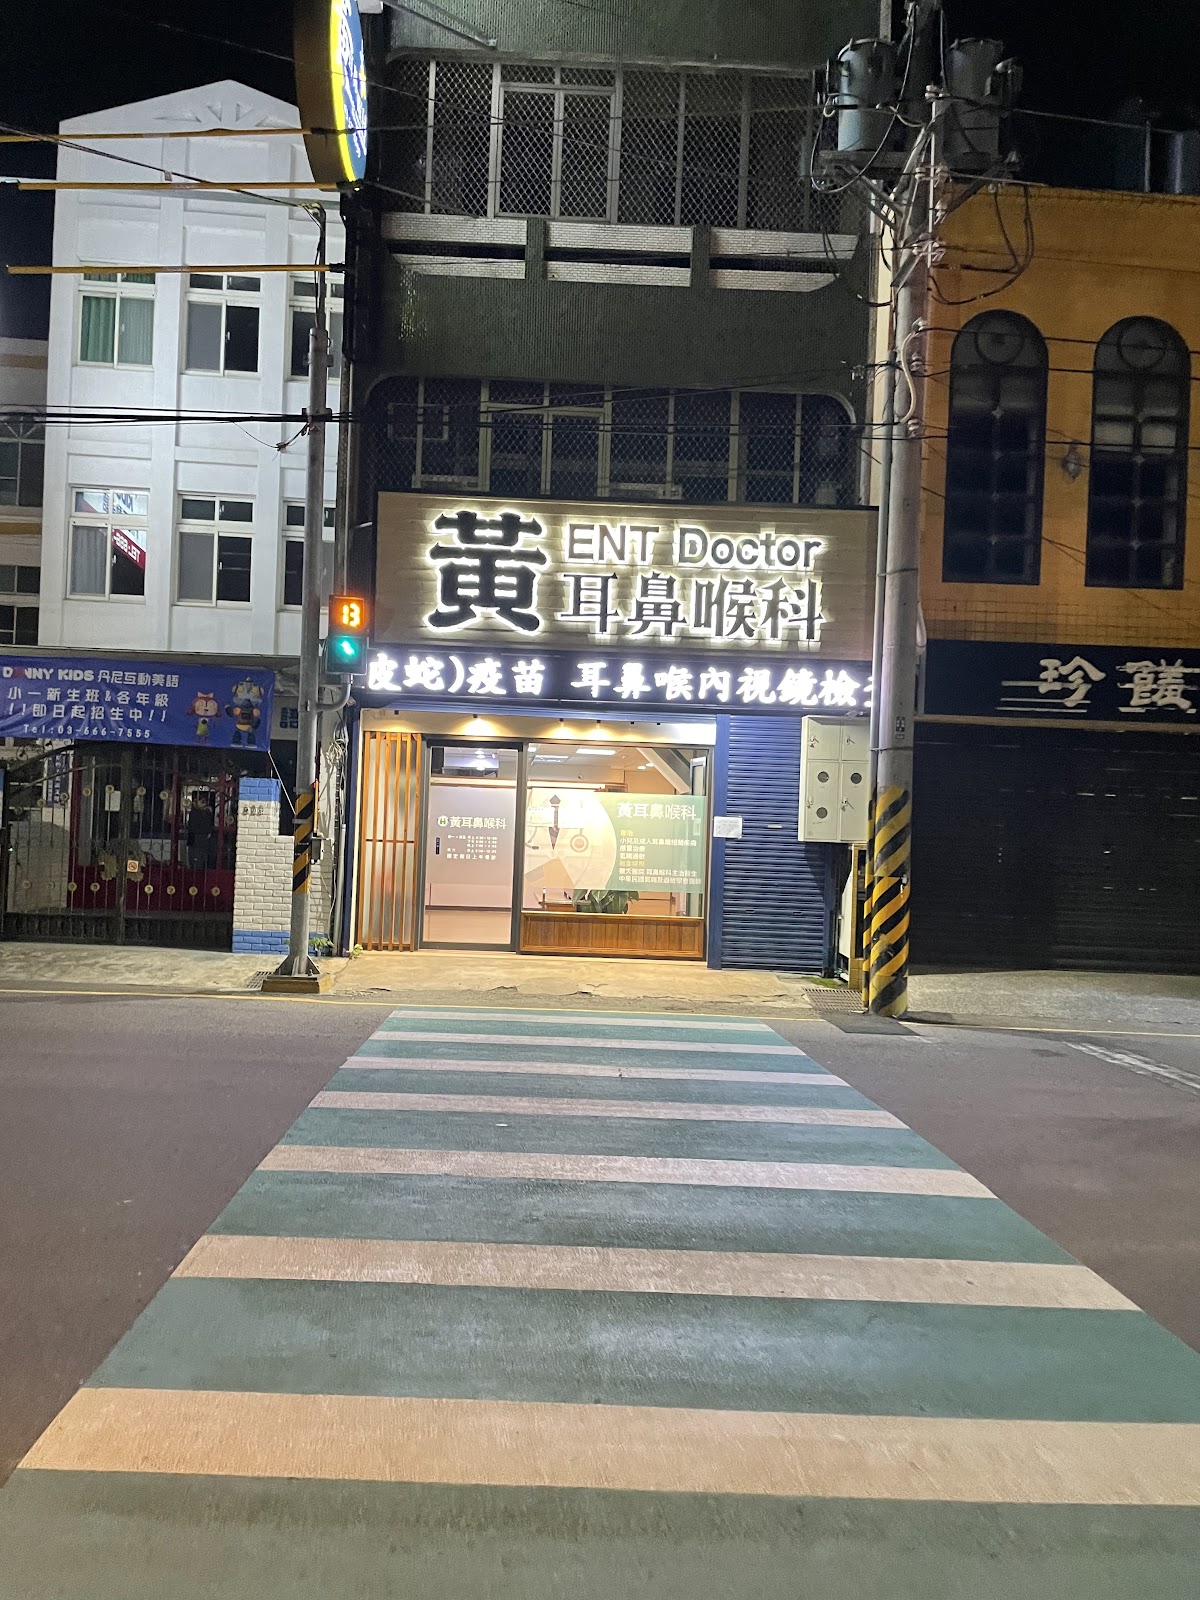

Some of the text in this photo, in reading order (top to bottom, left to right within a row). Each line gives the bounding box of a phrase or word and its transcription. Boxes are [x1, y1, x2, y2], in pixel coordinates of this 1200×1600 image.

[567, 523, 823, 569] ENT Doctor
[426, 508, 548, 633] 黃
[342, 602, 361, 628] 13
[561, 571, 826, 639] 耳鼻喉科
[2, 666, 180, 688] DNNY KIDS 丹尼互動美語
[7, 686, 169, 708] 小一新生班&各年級
[449, 815, 507, 830] 黃耳鼻喉科
[617, 802, 697, 820] 黃耳鼻喉科
